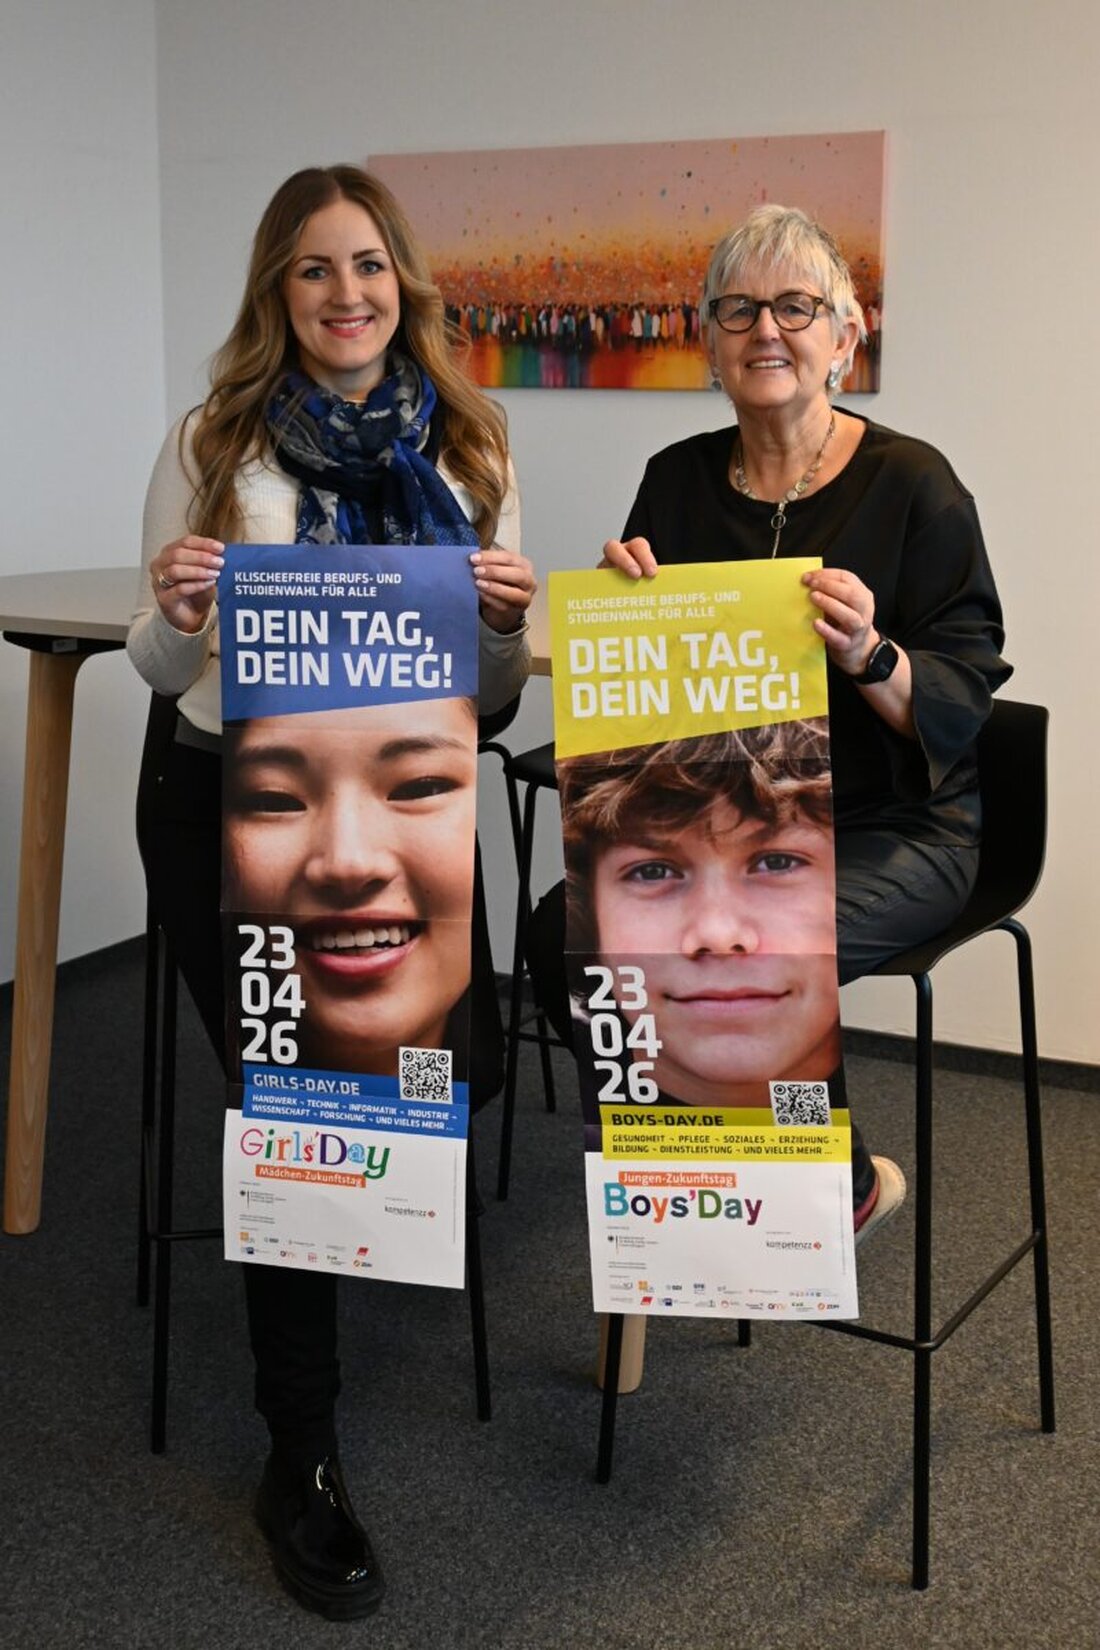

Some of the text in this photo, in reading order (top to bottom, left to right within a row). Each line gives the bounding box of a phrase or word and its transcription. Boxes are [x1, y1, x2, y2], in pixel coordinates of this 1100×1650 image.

[234, 571, 402, 584] KLISCHEEFREIE BERUFS- UND
[235, 584, 377, 597] STUDIENWAHL FÜR ALLE
[567, 591, 740, 611] KLISCHEEFREIE BERUFS- UND
[568, 605, 715, 624] STUDIENWAHL FÜR ALLE
[235, 609, 434, 652] DEIN TAG,
[569, 630, 779, 674] DEIN TAG,
[237, 650, 452, 688] DEIN WEG!
[571, 672, 801, 718] DEIN WEG!
[238, 924, 296, 970] 23
[241, 971, 306, 1018] 04
[583, 965, 648, 1010] 23
[240, 1018, 298, 1065] 26
[590, 1013, 663, 1058] 04
[253, 1073, 360, 1096] GIRLS-DAY.DE
[593, 1060, 659, 1104] 26
[252, 1094, 449, 1120] HANDWERK TECHNIK INFORMATIK INDUSTRIE
[252, 1104, 310, 1117] WISSENSCHAFT
[320, 1110, 366, 1122] FORSCHUNG
[375, 1116, 392, 1124] UND
[394, 1118, 420, 1128] VIELES
[421, 1120, 445, 1130] MEHR
[612, 1113, 725, 1127] BOYS-DAY.DE
[612, 1134, 830, 1144] GESUNDHEIT PFLEGE SOZIALES ERZIEHUNG
[612, 1144, 650, 1153] BILDUNG
[659, 1145, 733, 1154] DIENSTLEISTUNG
[743, 1145, 762, 1154] UND
[764, 1146, 794, 1154] VIELES
[796, 1146, 822, 1155] MEHR
[259, 1166, 362, 1188] Mädchen-Zukunftstag
[621, 1172, 734, 1189] Jungen-Zukunftstag
